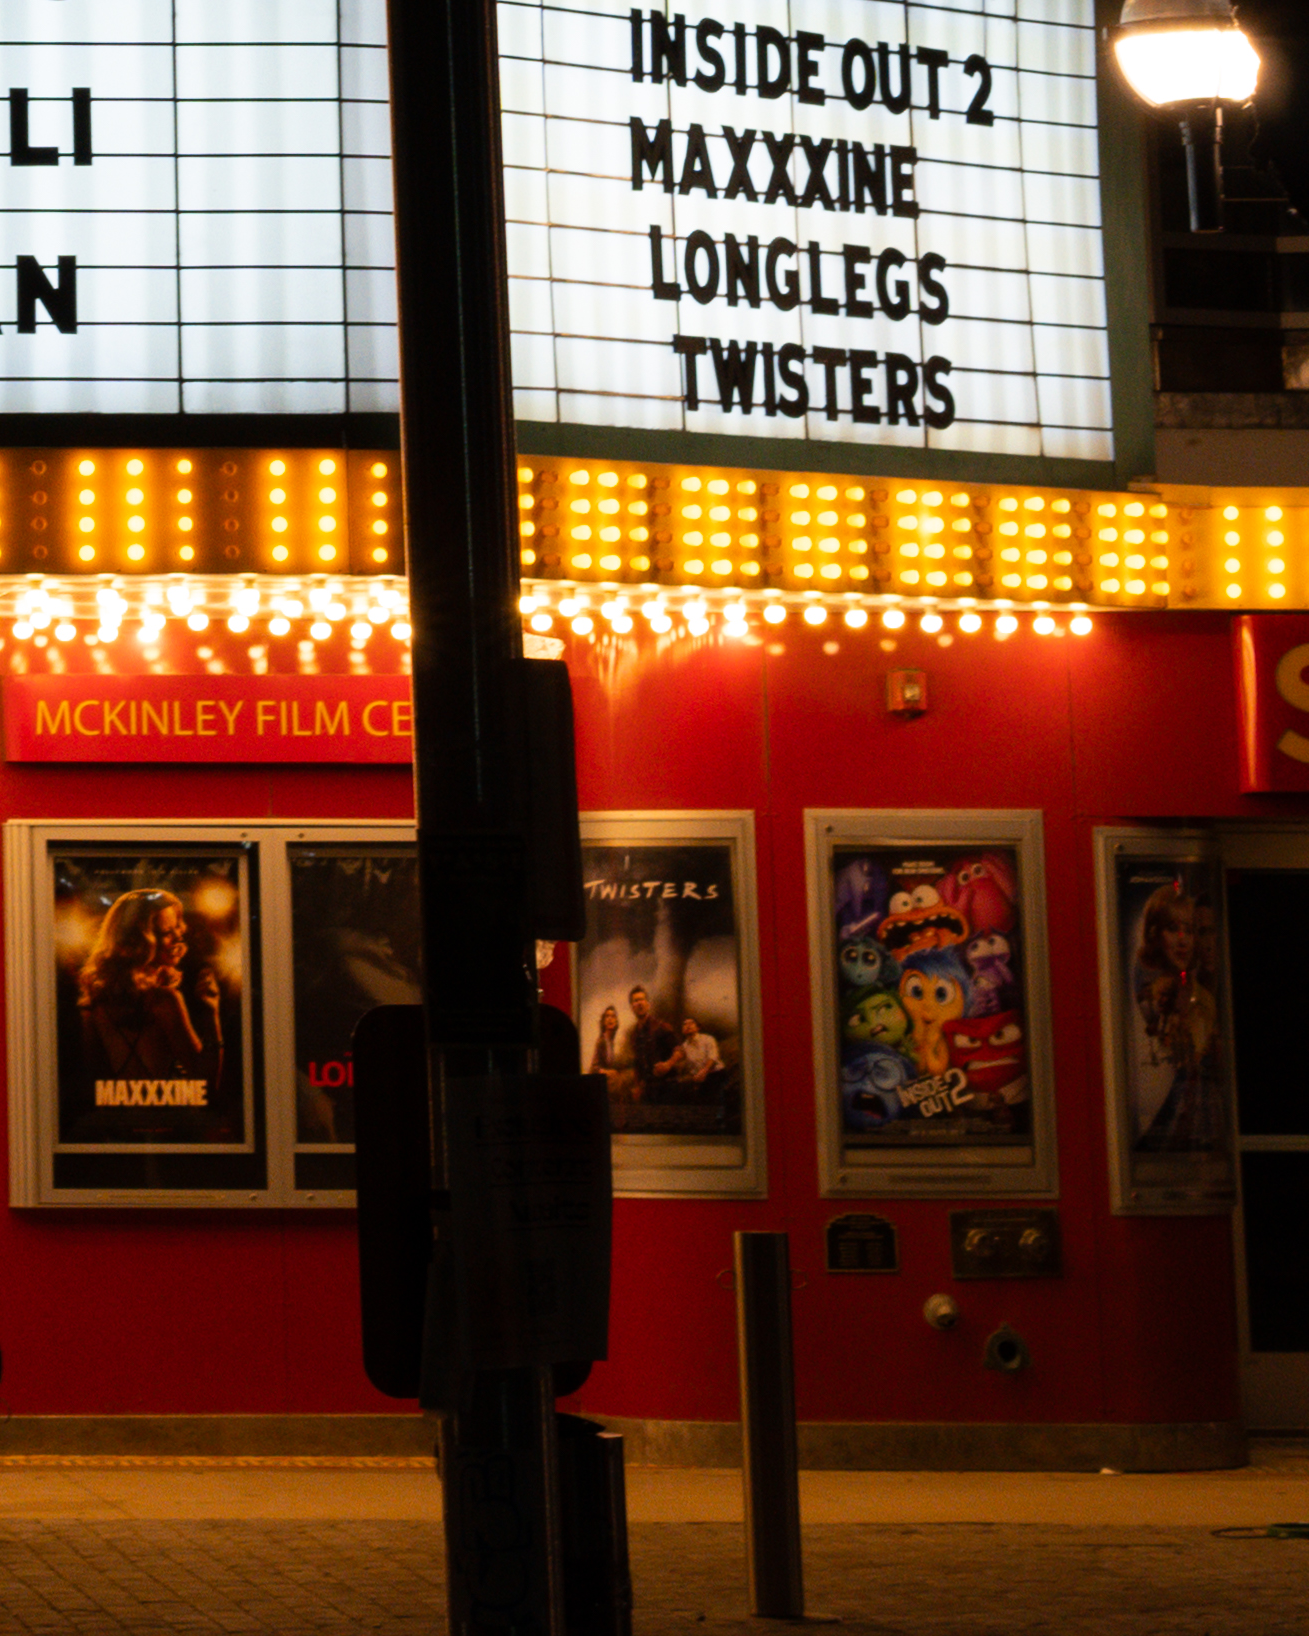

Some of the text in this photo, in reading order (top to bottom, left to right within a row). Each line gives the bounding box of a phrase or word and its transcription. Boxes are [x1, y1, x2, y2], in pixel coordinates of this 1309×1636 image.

[629, 8, 995, 127] INSIDE OUT 2
[629, 116, 920, 220] MAXXXINE
[649, 224, 949, 327] LONGLEGS
[672, 334, 956, 431] TWISTERS
[35, 699, 244, 736] MCKINLEY
[255, 699, 351, 736] FILM
[583, 879, 720, 902] TWISTERS
[94, 1078, 209, 1107] MAXXXINE
[943, 1067, 976, 1107] 2
